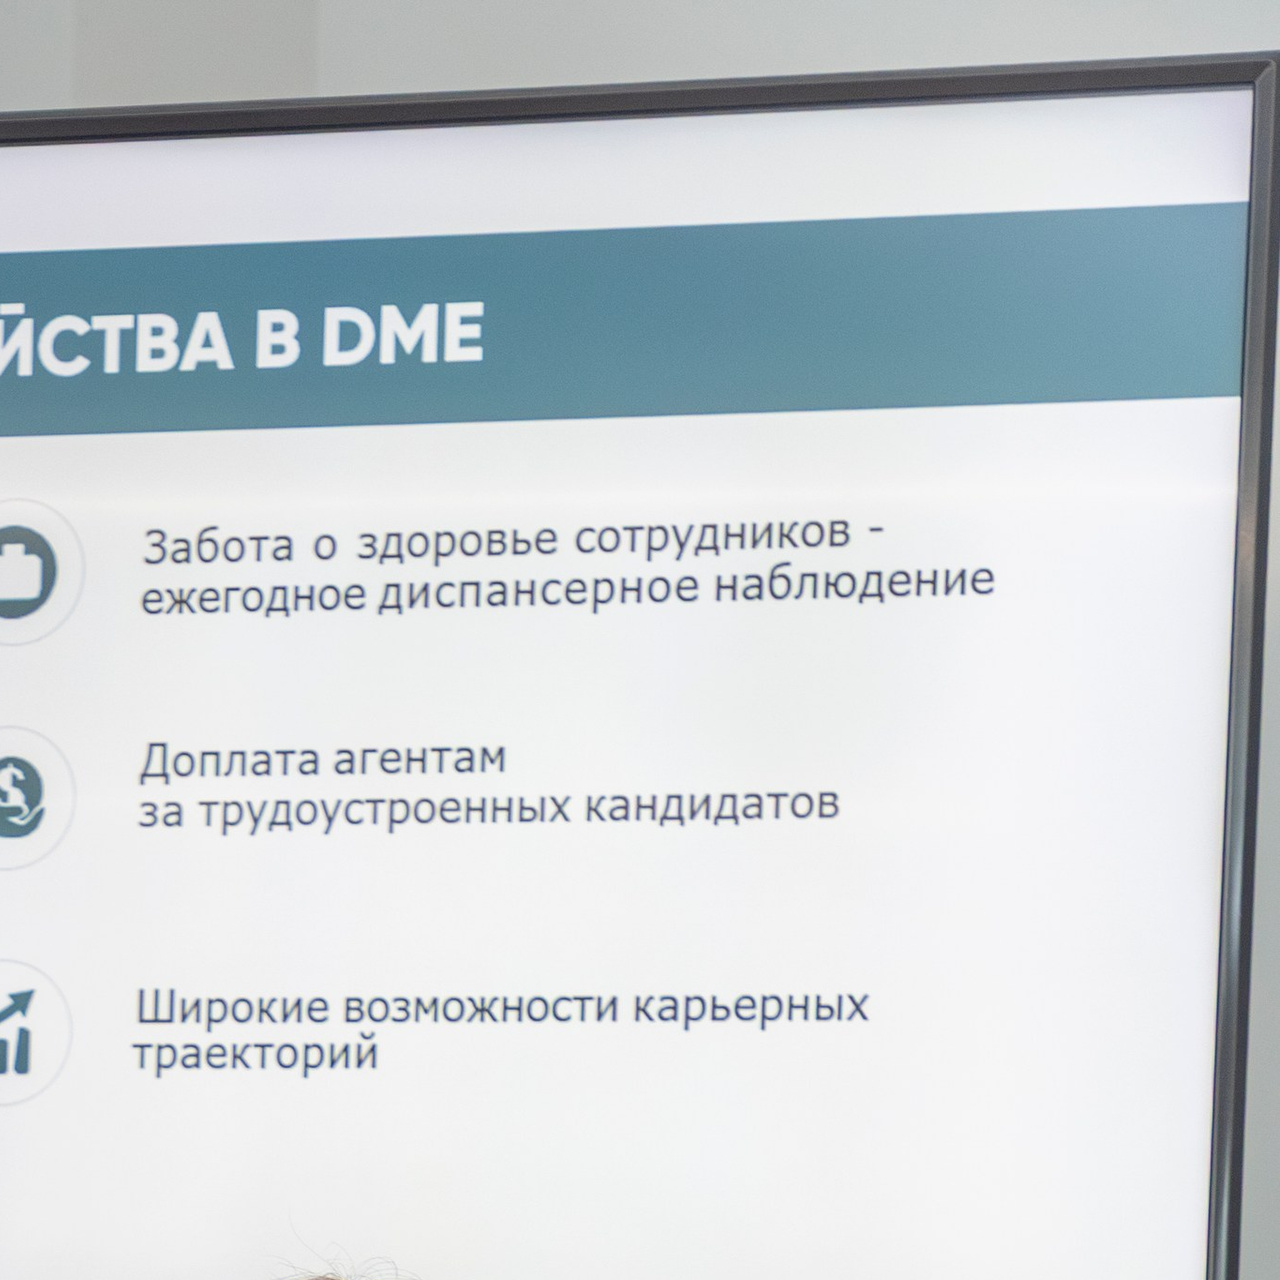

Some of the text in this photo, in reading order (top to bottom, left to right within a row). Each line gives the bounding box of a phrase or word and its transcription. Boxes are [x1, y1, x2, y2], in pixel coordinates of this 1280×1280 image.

[255, 308, 301, 369] В
[322, 301, 485, 367] DME
[144, 525, 293, 565] Забота
[313, 534, 338, 561] о
[357, 528, 558, 568] здоровье
[575, 519, 851, 562] сотрудников
[141, 561, 995, 618] ежегодное диспансерное наблюдение
[139, 742, 506, 786] Доплата агентам
[138, 791, 840, 837] за трудоустроенных кандидатов
[138, 988, 869, 1033] Широкие возможности карьерных
[131, 1031, 378, 1079] траекторий
